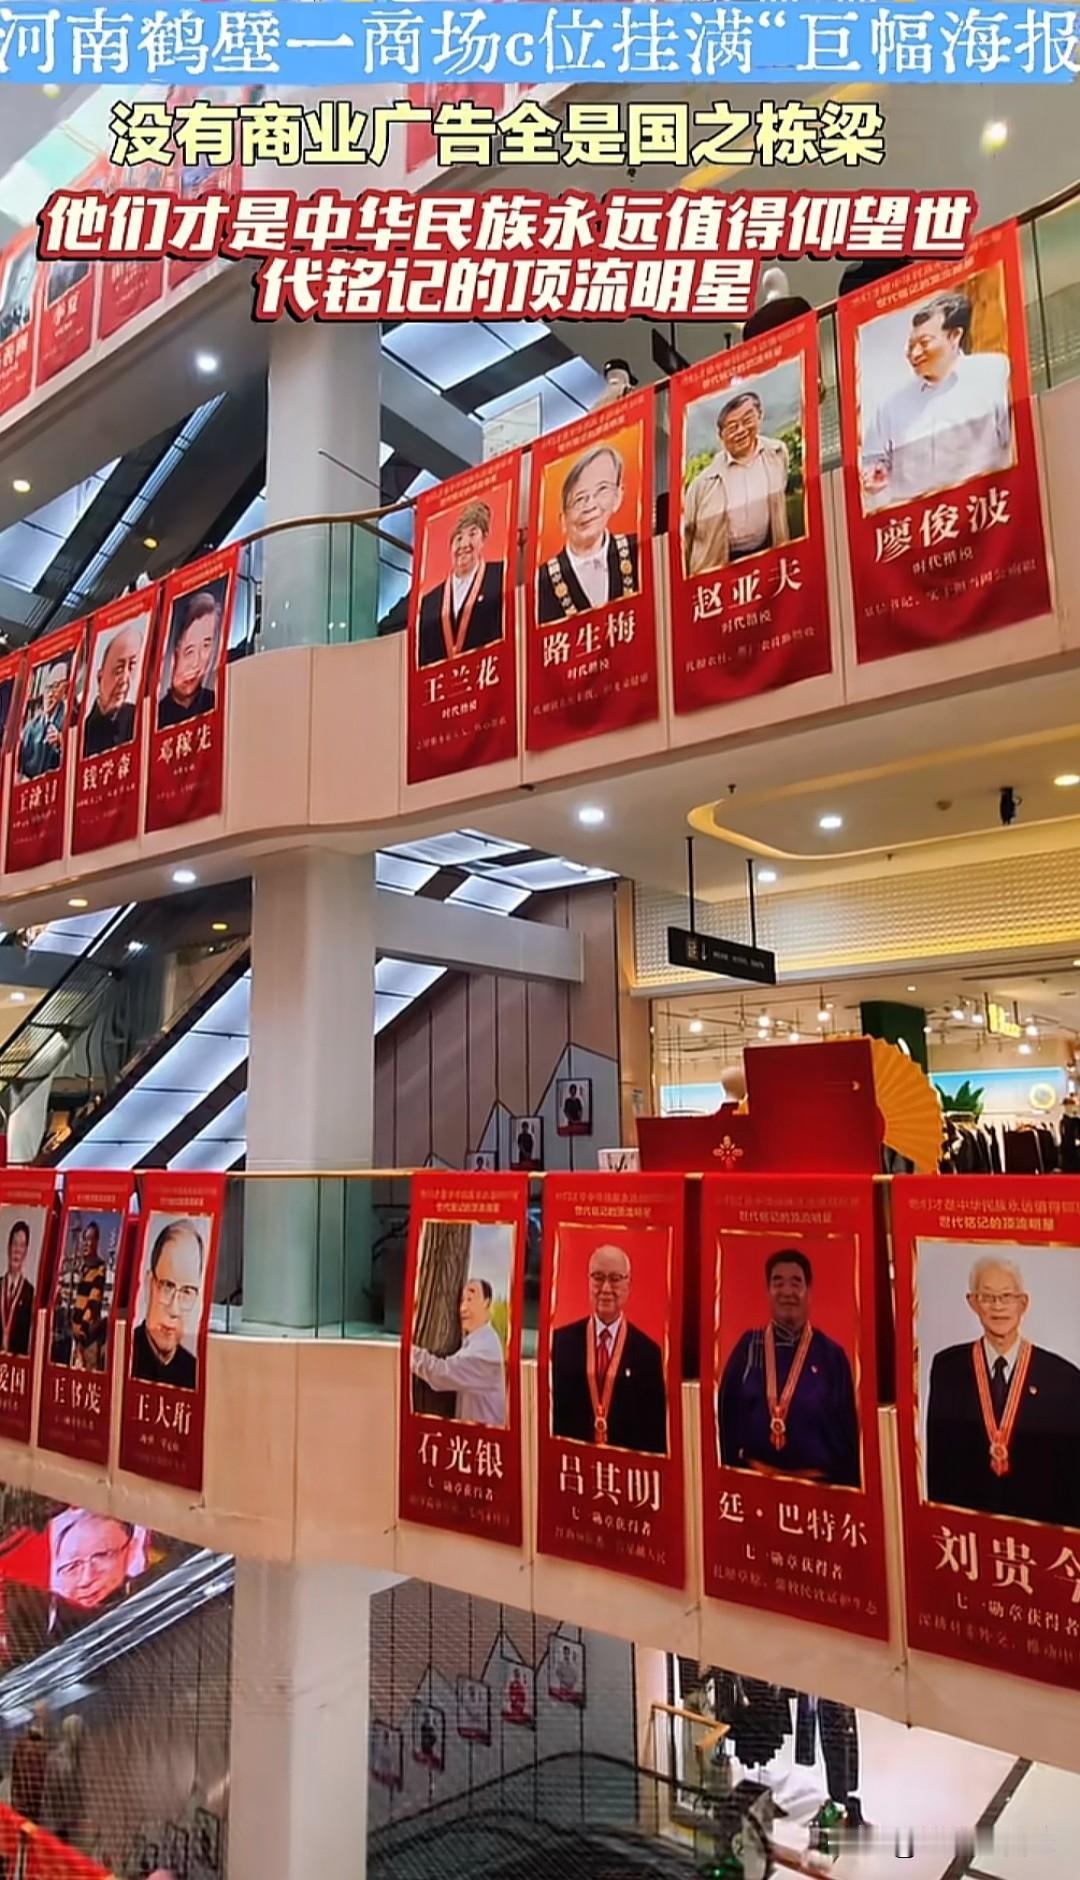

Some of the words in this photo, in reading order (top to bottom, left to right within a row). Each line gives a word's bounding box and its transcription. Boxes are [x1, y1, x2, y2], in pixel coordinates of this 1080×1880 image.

[875, 487, 1012, 563] 廖俊波
[693, 558, 803, 624] 赵亚夫
[543, 609, 637, 668] 路生梅
[421, 655, 499, 706] 王兰花
[418, 1431, 504, 1480] 石光银
[559, 1453, 661, 1511] 吕其明
[718, 1490, 868, 1549] 廷·巴特尔
